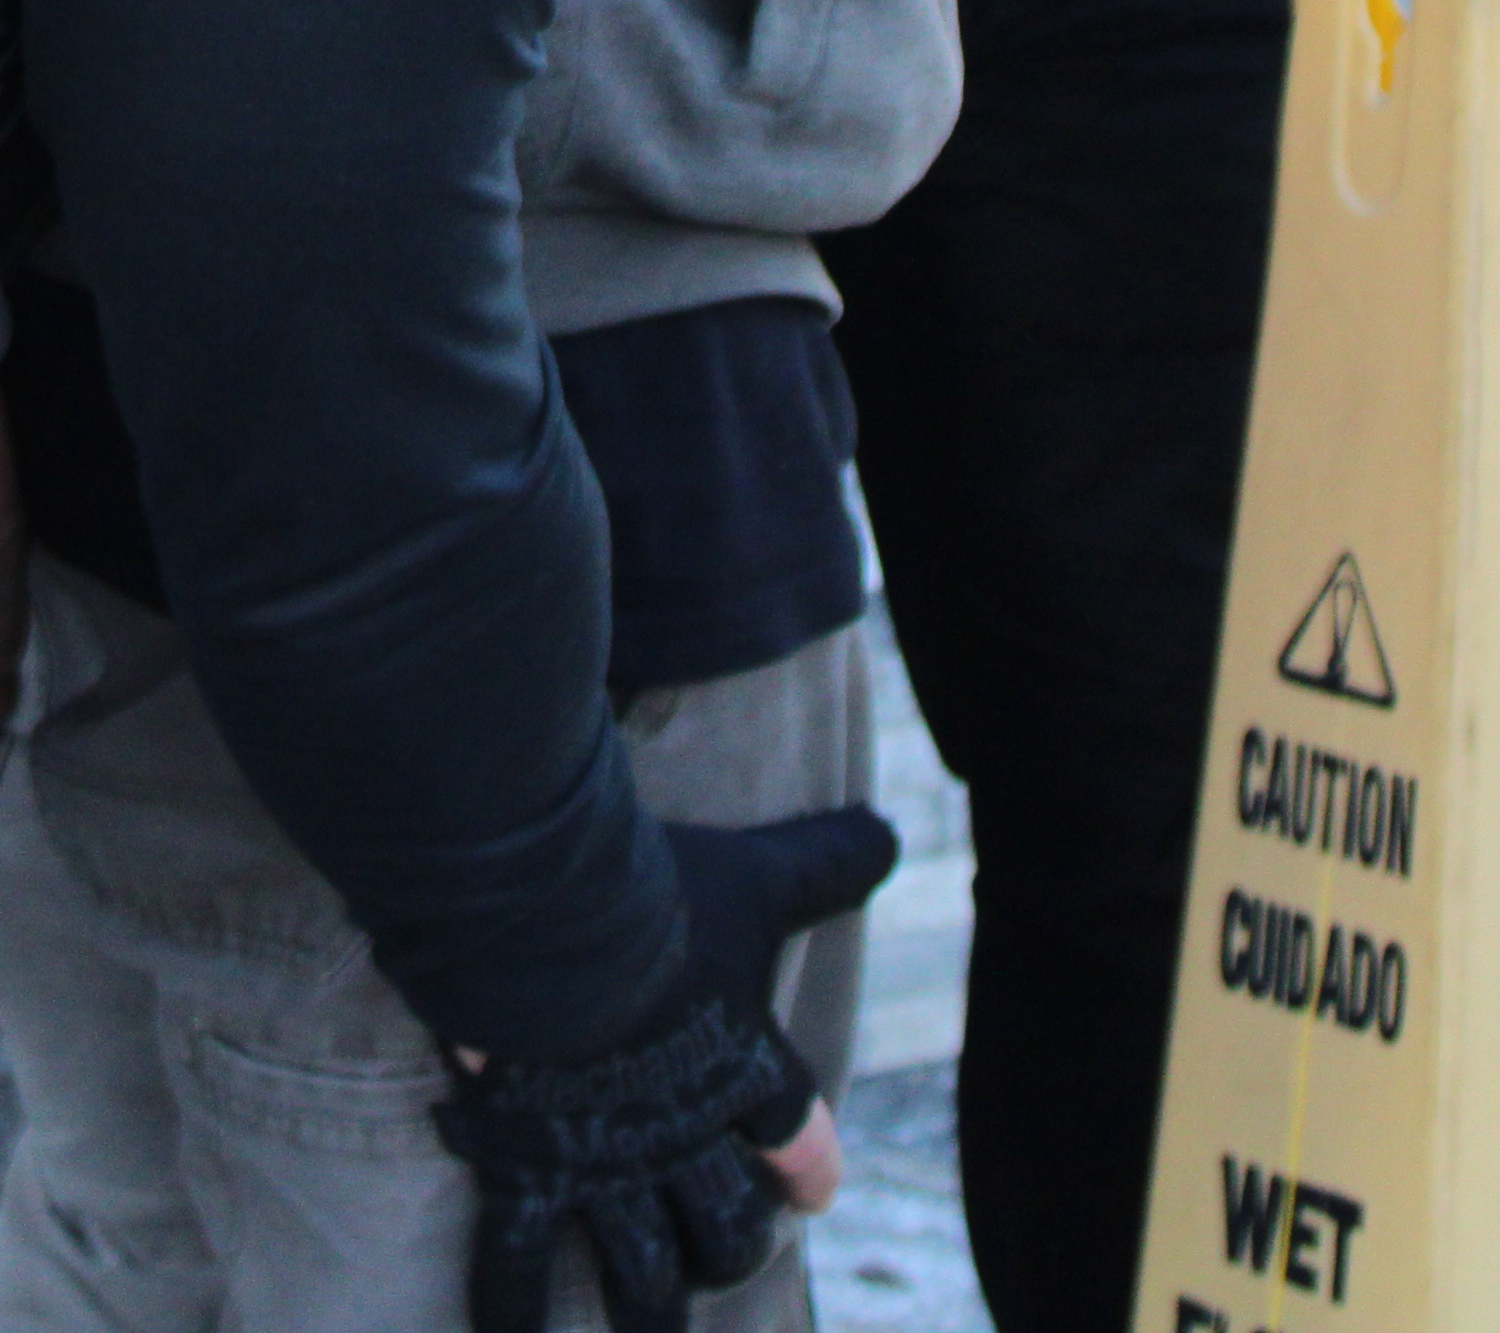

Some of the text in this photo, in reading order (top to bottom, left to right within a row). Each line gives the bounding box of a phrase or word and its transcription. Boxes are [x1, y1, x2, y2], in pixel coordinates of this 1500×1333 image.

[1237, 725, 1419, 882] CAUTION
[1220, 886, 1408, 1044] CUIDADO
[1220, 1152, 1365, 1306] WET
